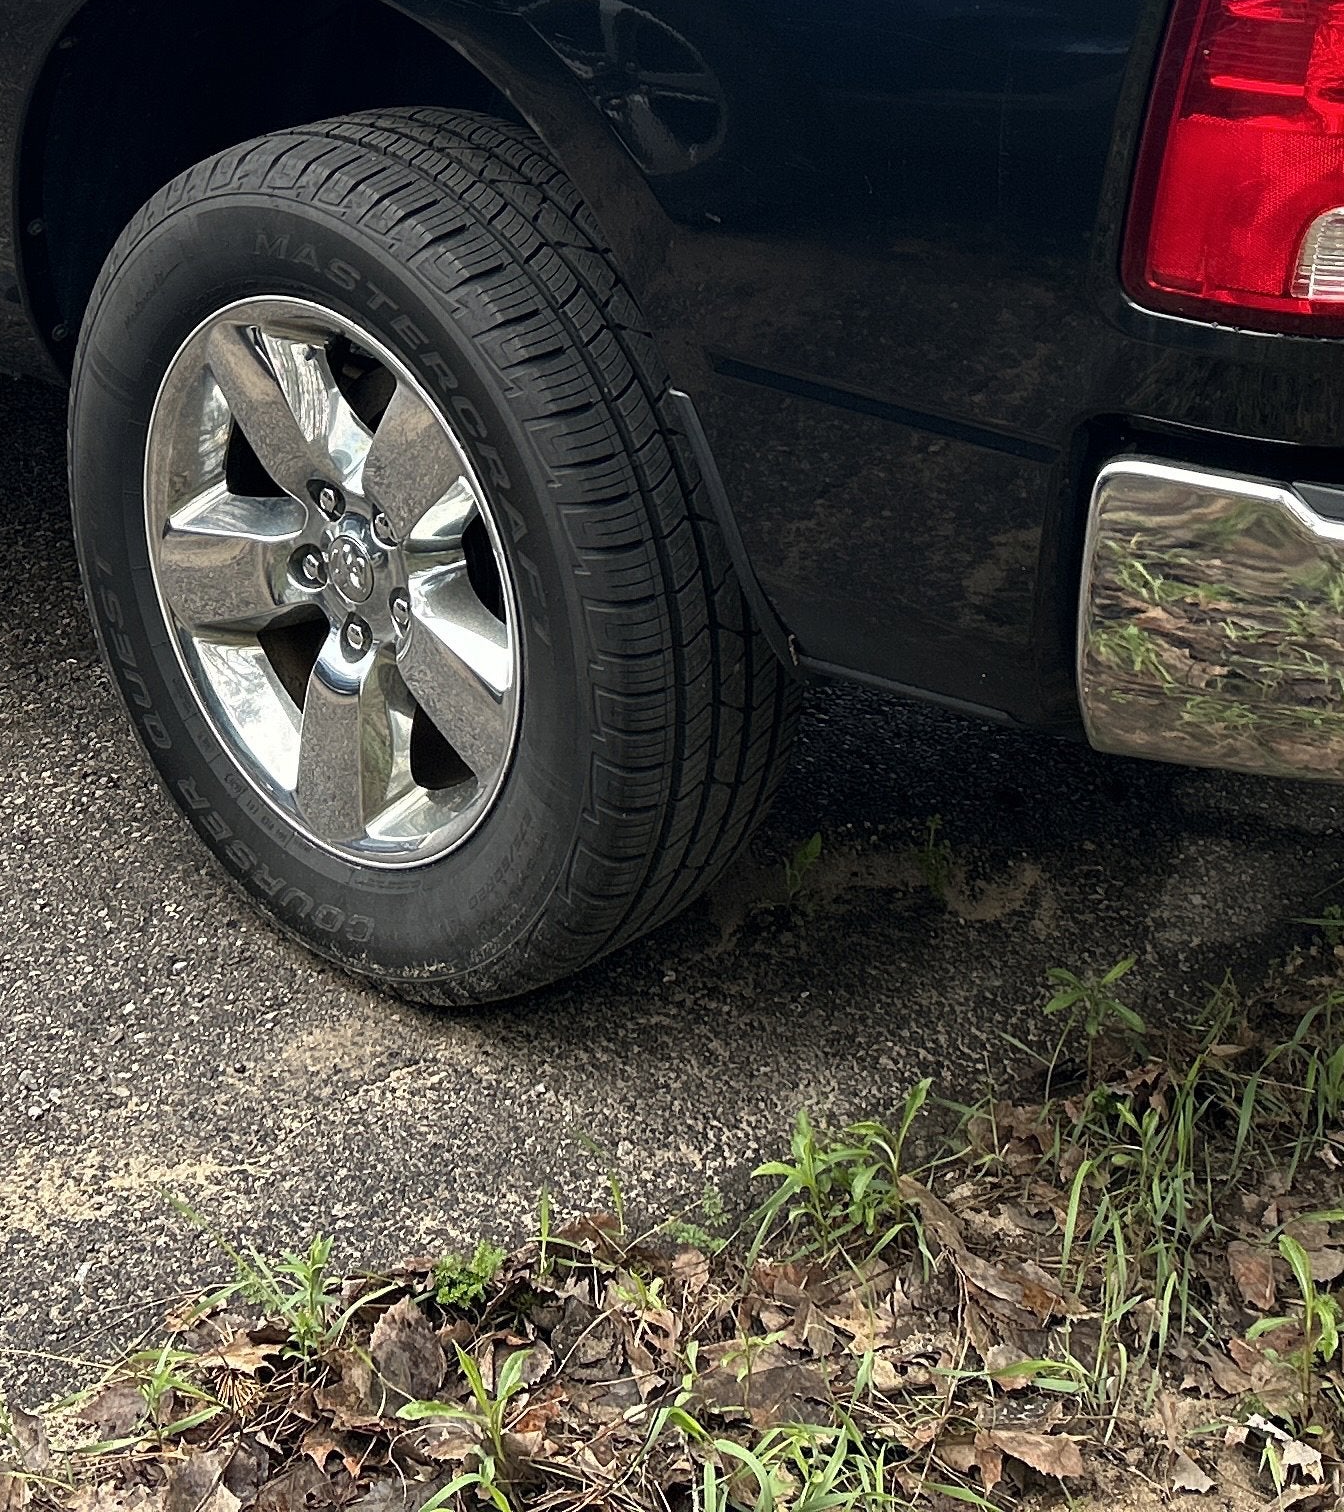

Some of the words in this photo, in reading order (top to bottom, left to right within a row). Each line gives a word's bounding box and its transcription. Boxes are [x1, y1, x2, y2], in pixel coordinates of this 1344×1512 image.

[254, 231, 552, 648] MASTERCRAFT
[92, 539, 172, 750] QUEST
[176, 775, 376, 944] COURSER
